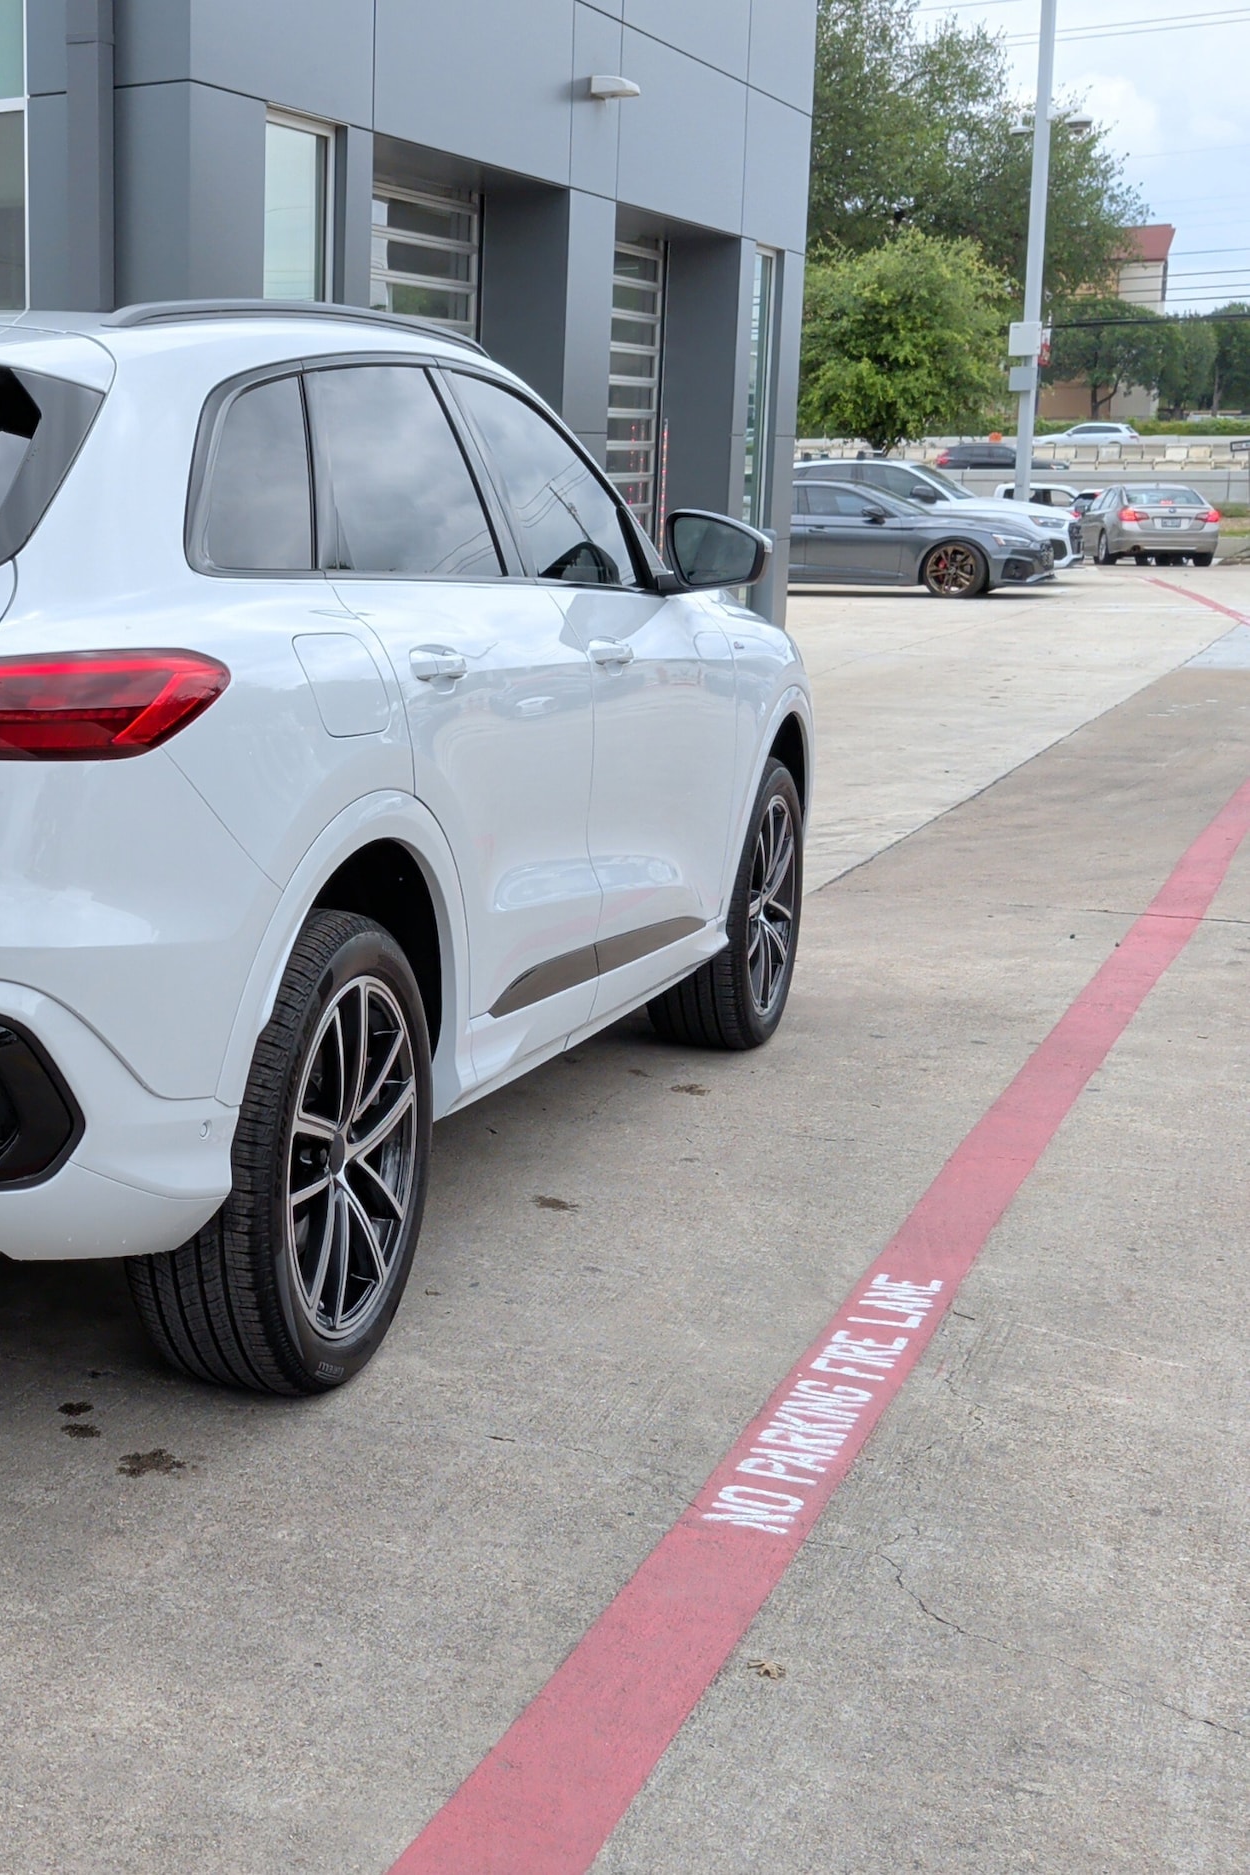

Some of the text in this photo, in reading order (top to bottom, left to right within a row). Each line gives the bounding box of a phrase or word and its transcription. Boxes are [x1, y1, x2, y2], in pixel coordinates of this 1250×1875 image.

[702, 1273, 944, 1535] NO PARKING FIRE LANE
